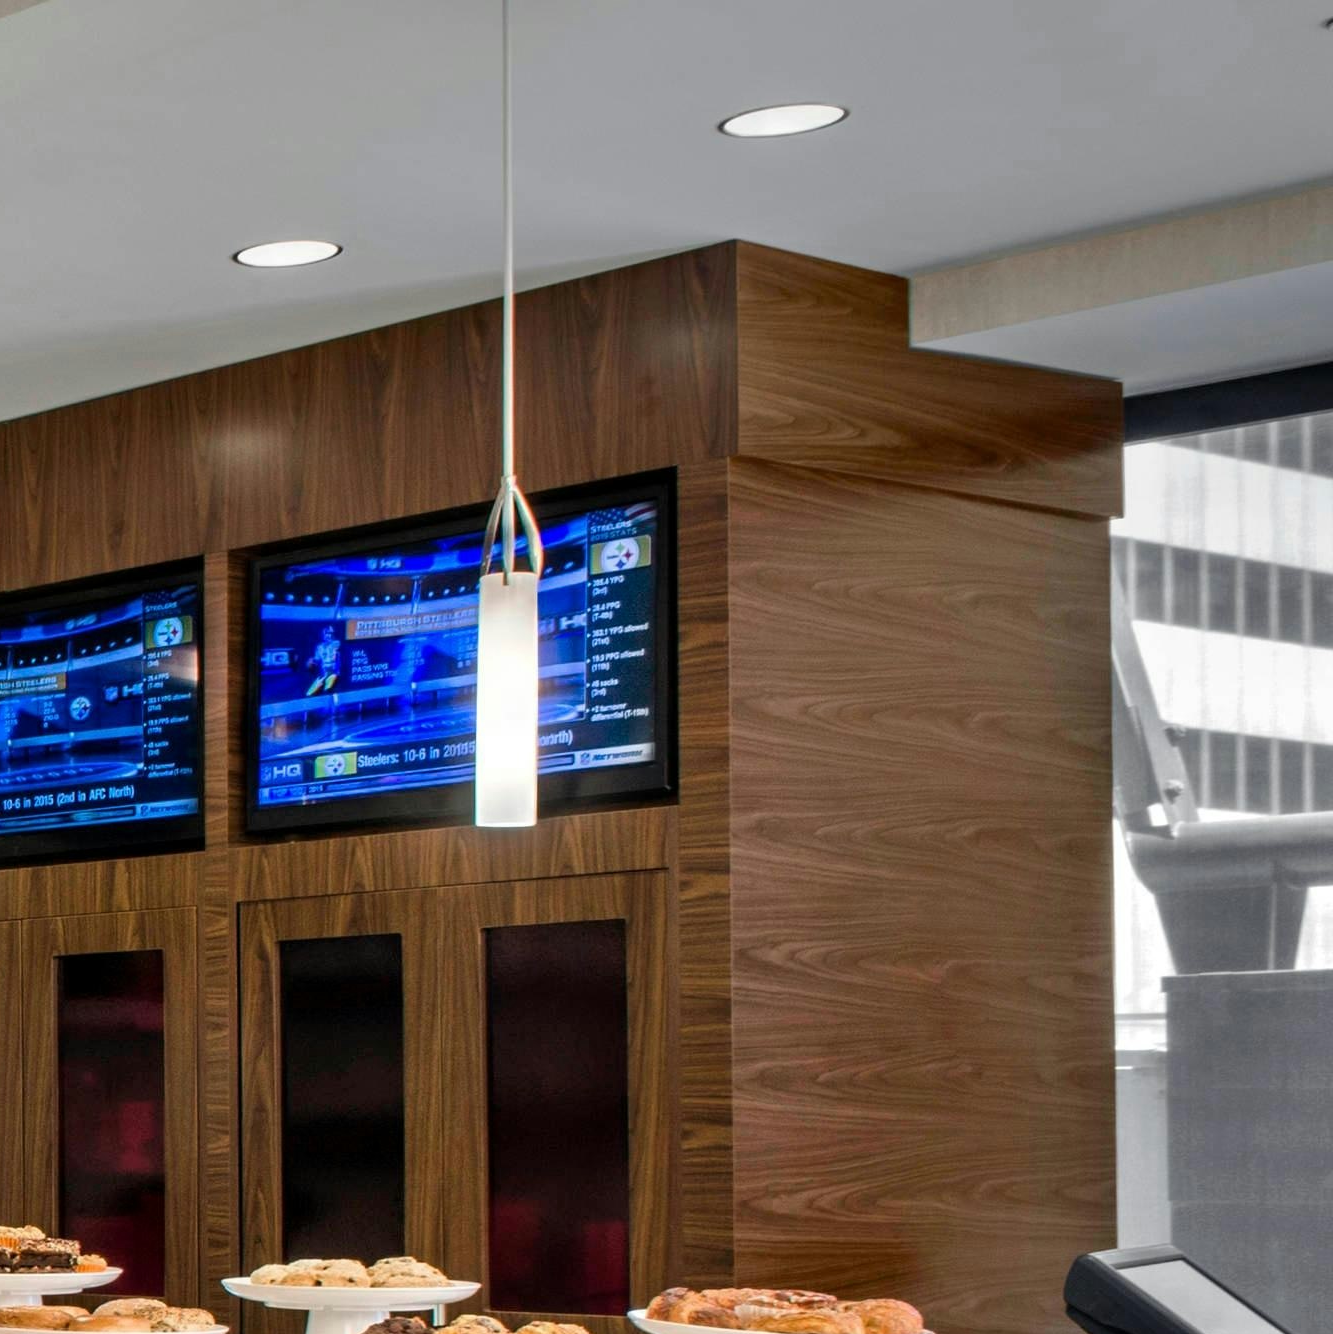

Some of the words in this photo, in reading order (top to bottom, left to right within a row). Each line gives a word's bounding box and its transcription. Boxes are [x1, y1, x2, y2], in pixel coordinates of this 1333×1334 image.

[357, 752, 400, 768] Steelers:
[403, 747, 426, 763] 10-6
[429, 746, 440, 760] in
[272, 764, 301, 780] HQ
[2, 799, 21, 811] 10-6
[23, 797, 32, 809] in
[33, 795, 54, 807] 2015
[57, 792, 75, 807] (2nd
[77, 791, 86, 802] in
[89, 788, 107, 801] AFC
